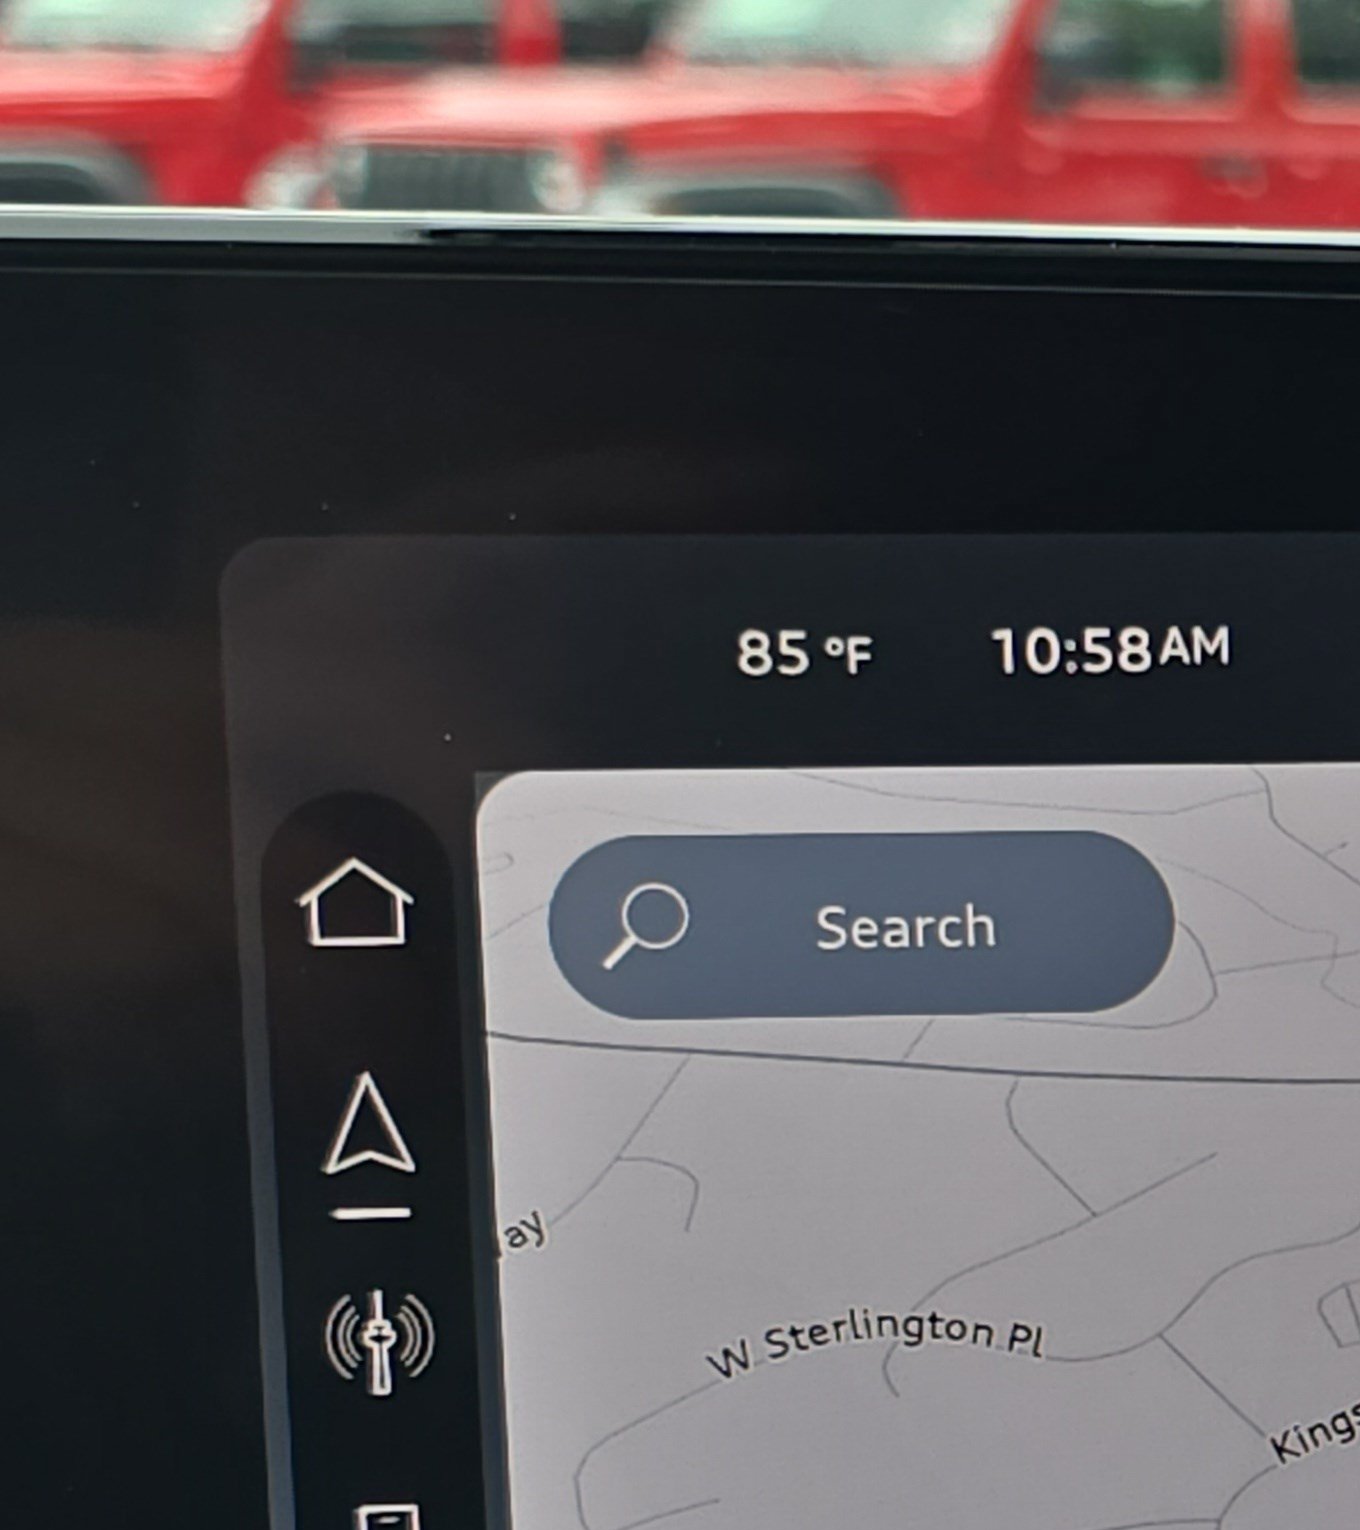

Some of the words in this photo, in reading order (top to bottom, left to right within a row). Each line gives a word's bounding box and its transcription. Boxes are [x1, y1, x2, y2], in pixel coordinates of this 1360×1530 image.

[737, 629, 810, 677] 85
[824, 635, 873, 675] °F
[817, 903, 998, 950] Search
[497, 1210, 546, 1257] ay
[707, 1339, 750, 1380] W
[764, 1307, 993, 1360] Sterlington
[1008, 1323, 1043, 1358] Pl
